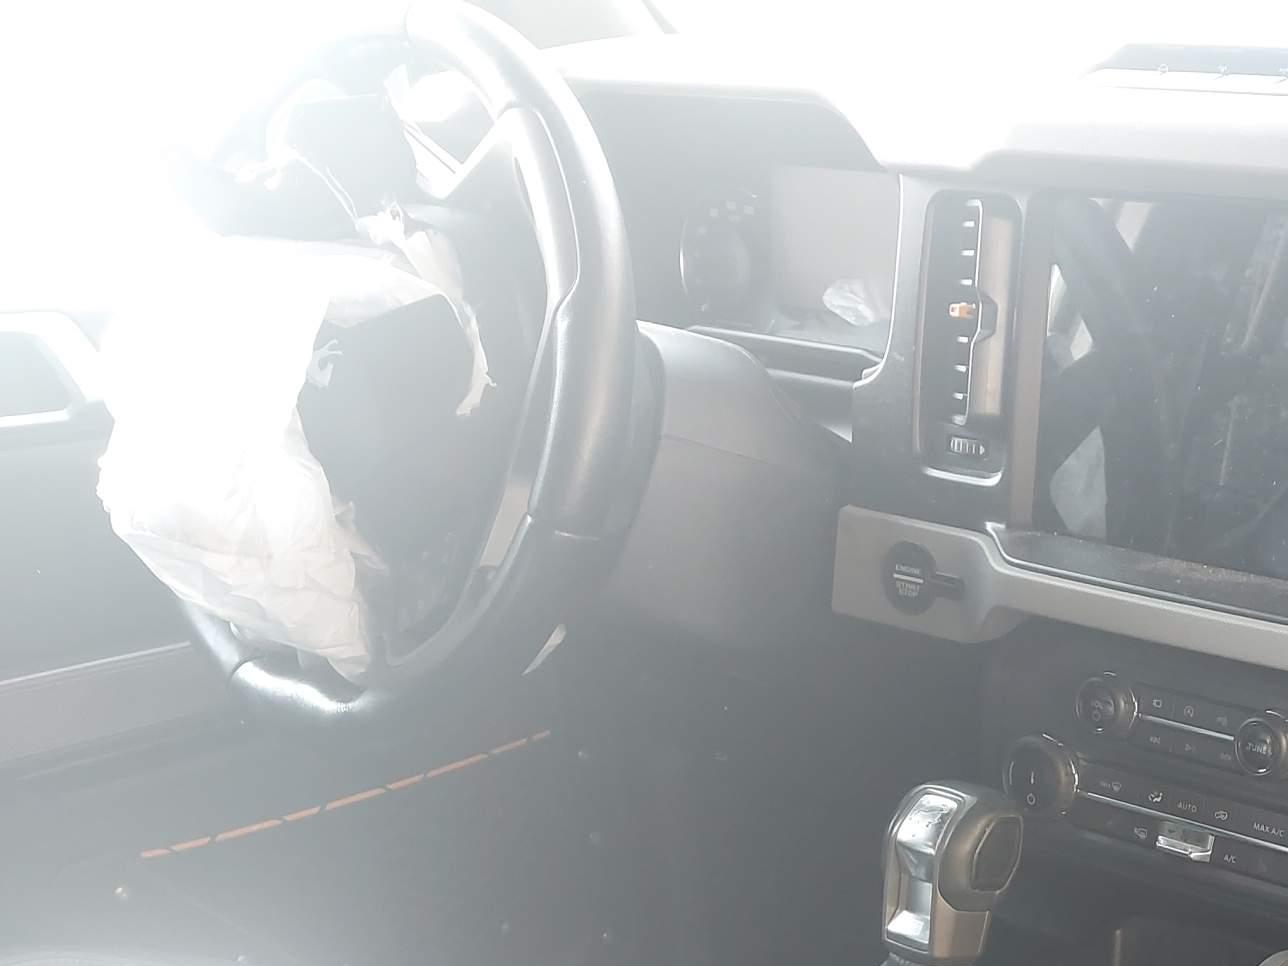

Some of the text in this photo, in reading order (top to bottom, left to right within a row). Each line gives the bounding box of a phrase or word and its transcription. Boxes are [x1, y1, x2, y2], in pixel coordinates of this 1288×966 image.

[895, 564, 921, 575] ENGINE
[897, 588, 919, 598] STOP
[1177, 801, 1197, 813] AUTO
[1252, 821, 1286, 838] MAX A/C
[1223, 854, 1237, 864] A/C
